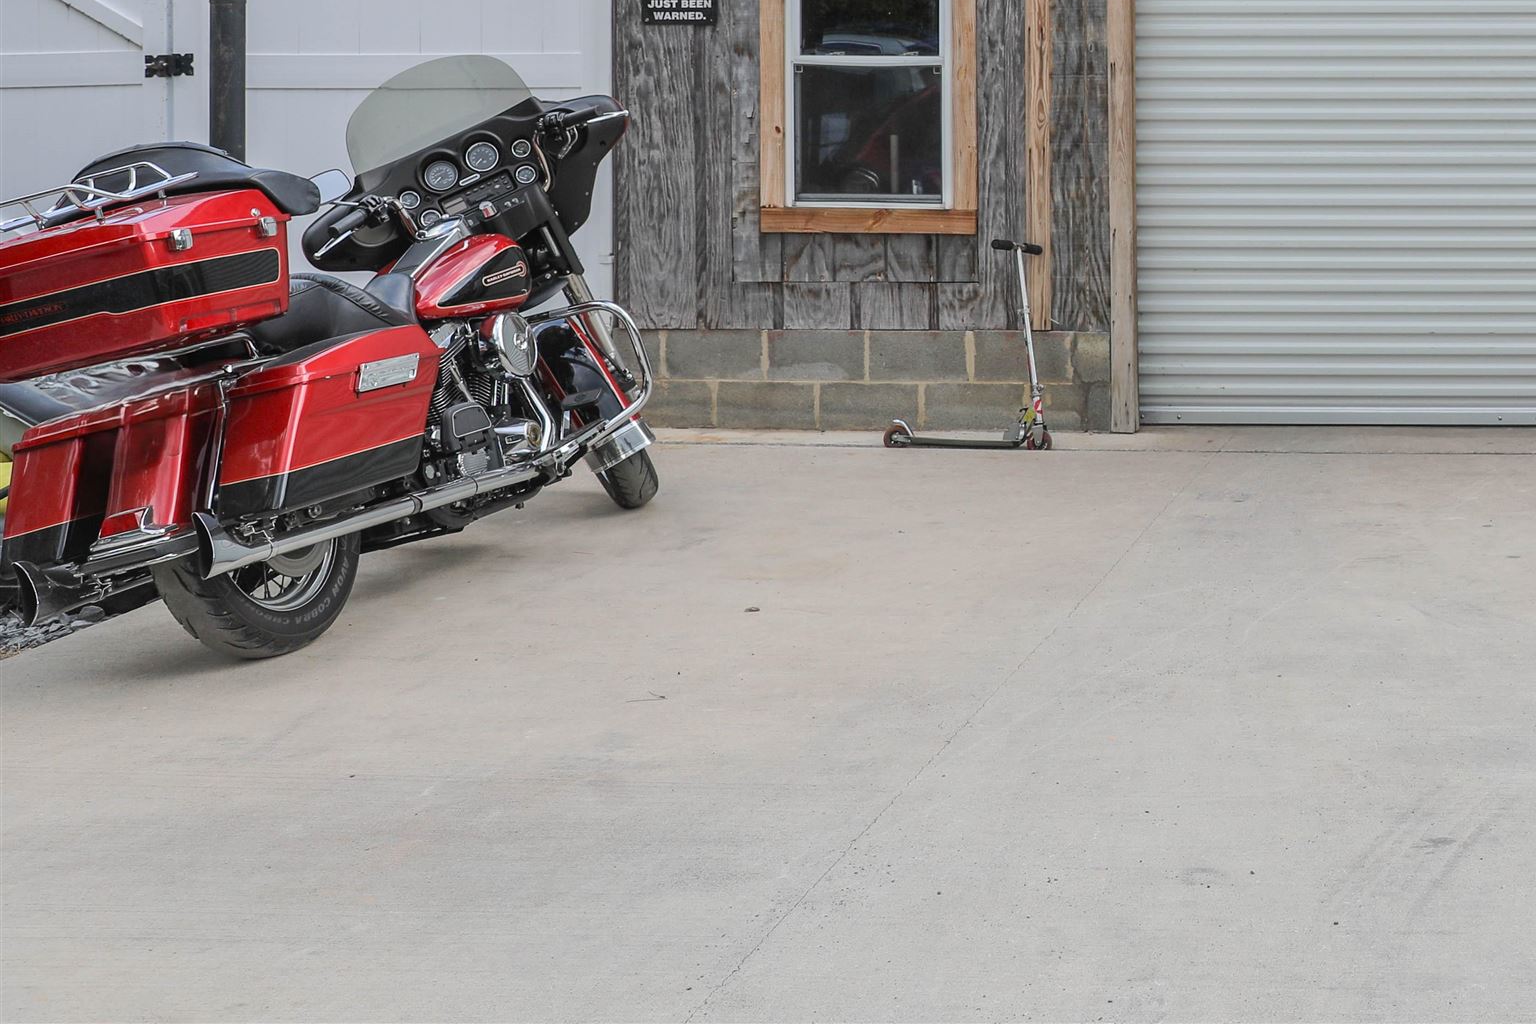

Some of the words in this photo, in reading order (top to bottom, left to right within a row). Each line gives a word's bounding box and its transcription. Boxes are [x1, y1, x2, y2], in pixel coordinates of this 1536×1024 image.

[648, 0, 678, 8] JUST
[681, 0, 711, 8] BEEN
[654, 12, 706, 20] WARNED.
